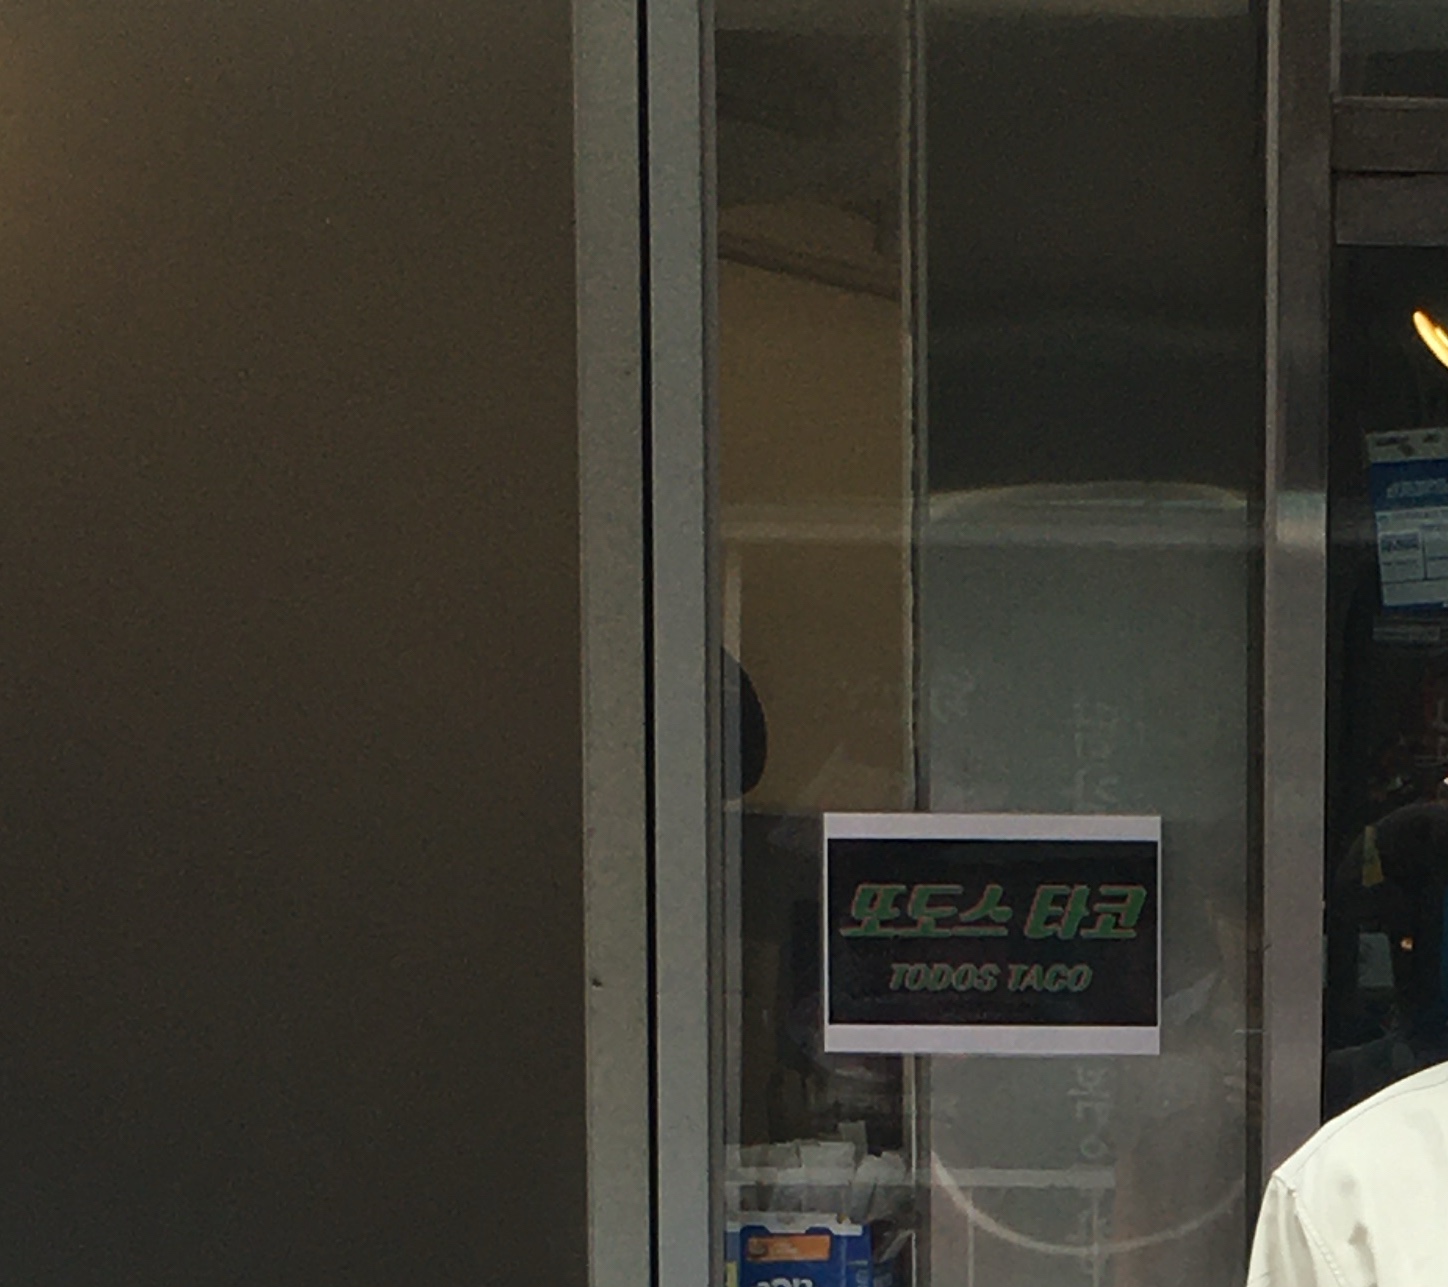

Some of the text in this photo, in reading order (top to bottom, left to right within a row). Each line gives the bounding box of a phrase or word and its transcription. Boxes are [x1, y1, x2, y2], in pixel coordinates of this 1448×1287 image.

[840, 884, 1148, 940] 또도스 타코
[889, 963, 1093, 993] TODOS TACO
